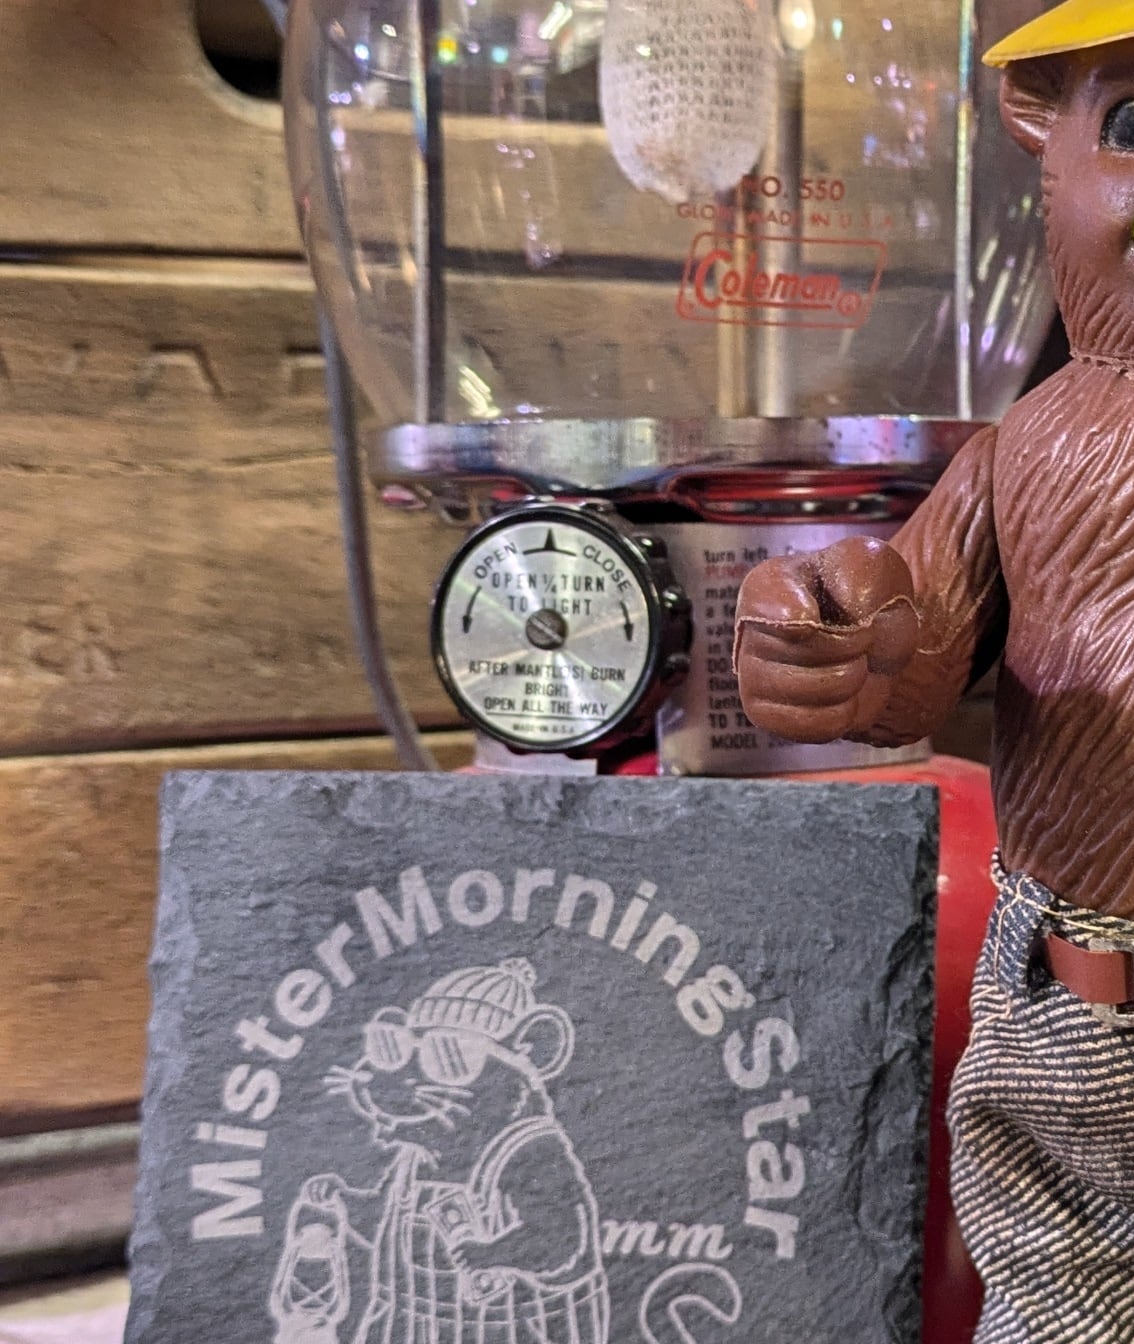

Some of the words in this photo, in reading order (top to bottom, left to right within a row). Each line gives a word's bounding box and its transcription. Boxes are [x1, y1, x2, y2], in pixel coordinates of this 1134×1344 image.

[801, 179, 846, 202] 550
[694, 249, 842, 310] Coleman
[474, 542, 518, 580] OPEN
[583, 544, 633, 593] CLOSE
[491, 571, 538, 590] OPEN
[561, 574, 605, 593] TURN
[508, 595, 527, 613] TO
[468, 660, 509, 675] AFTER
[591, 667, 626, 682] BURN
[525, 682, 569, 697] BRIGHT
[484, 696, 516, 711] OPEN
[521, 698, 544, 713] ALL
[551, 700, 573, 715] THE
[580, 702, 608, 717] WAY
